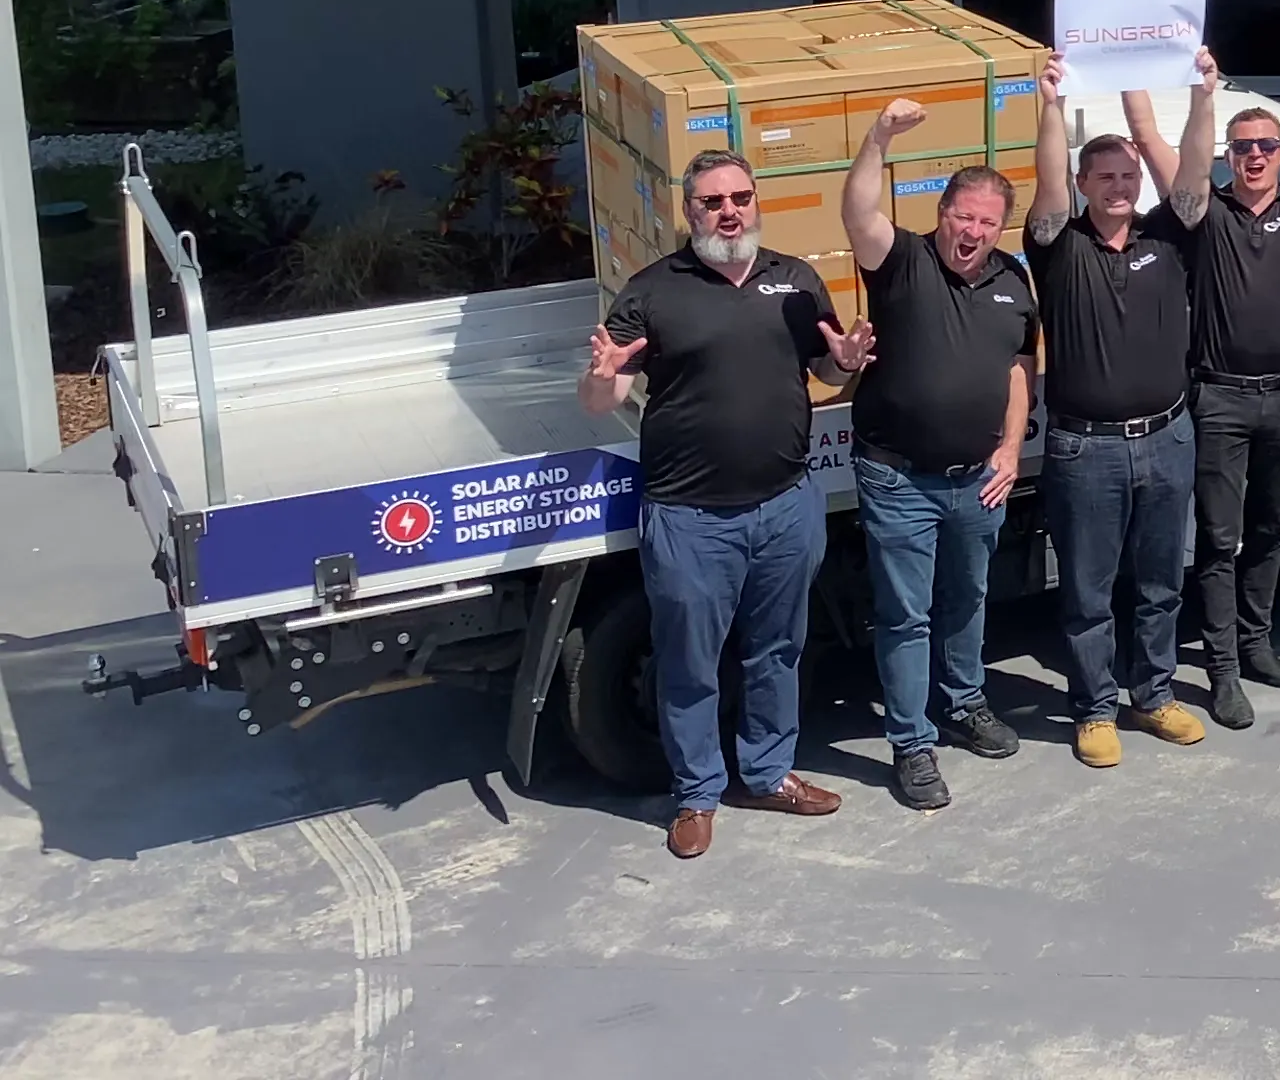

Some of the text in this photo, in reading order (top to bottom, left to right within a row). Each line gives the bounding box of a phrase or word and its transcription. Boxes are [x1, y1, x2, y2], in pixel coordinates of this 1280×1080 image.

[1065, 21, 1192, 44] SUNGROW
[451, 467, 569, 501] SOLAR AND
[453, 477, 633, 522] ENERGY STORAGE
[456, 504, 601, 544] DISTRIBUTION
